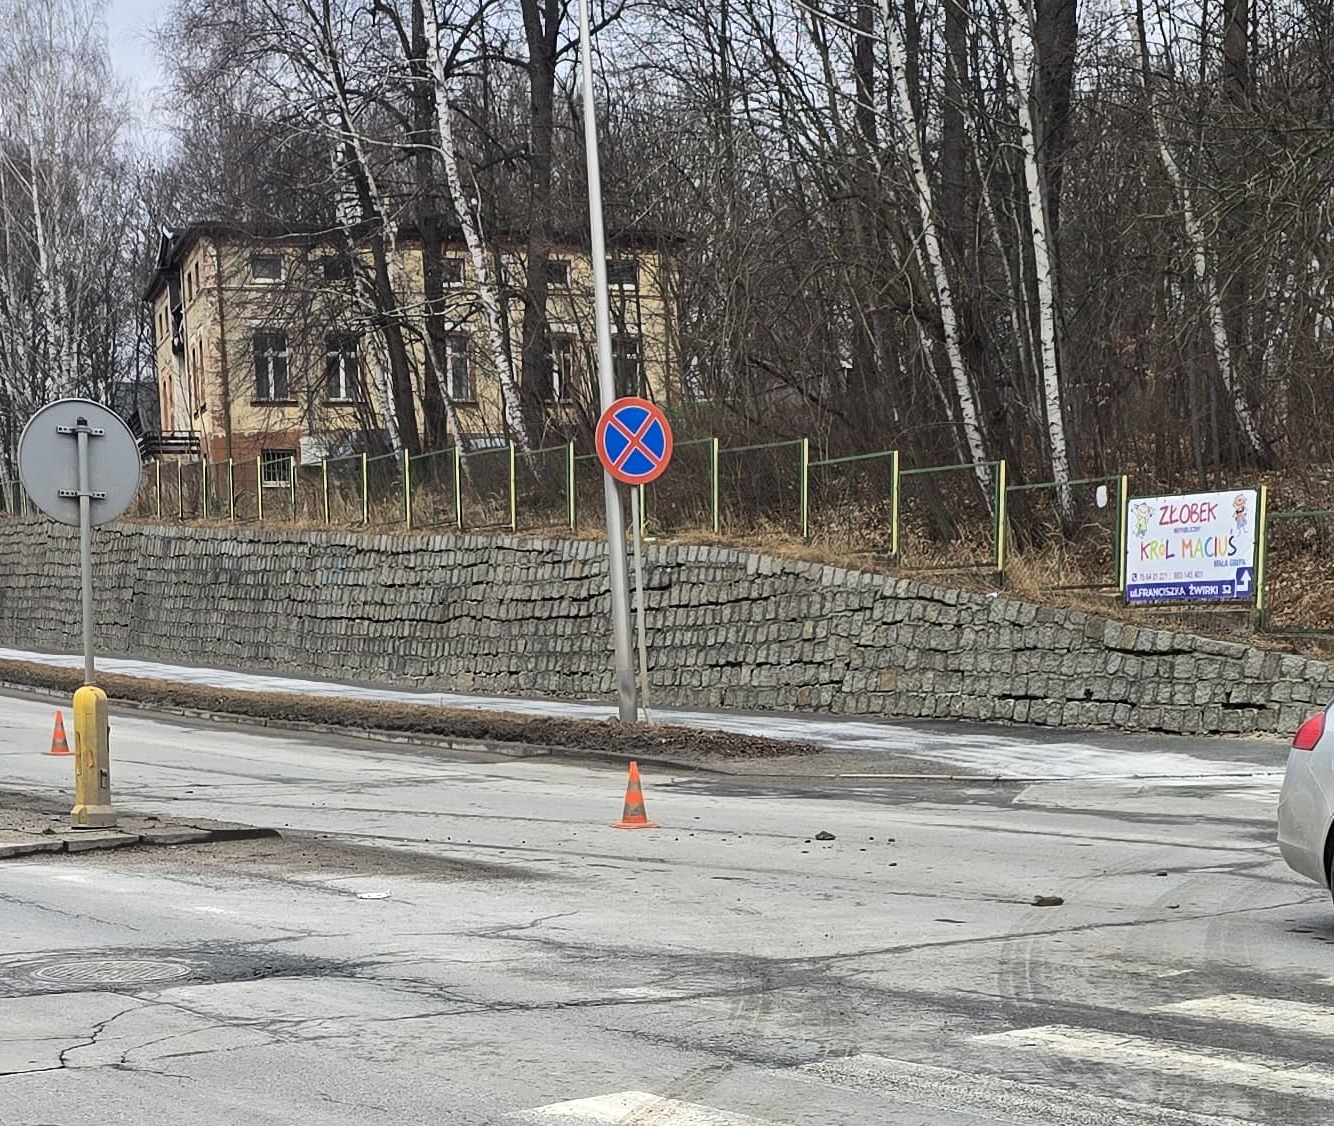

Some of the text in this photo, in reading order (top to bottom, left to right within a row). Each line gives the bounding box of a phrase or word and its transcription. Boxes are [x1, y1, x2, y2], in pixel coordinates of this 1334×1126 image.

[1158, 499, 1218, 525] ŻŁOBEK
[1140, 529, 1237, 561] KRÓL MACIUŚ
[1188, 583, 1218, 596] ŻWIRKI
